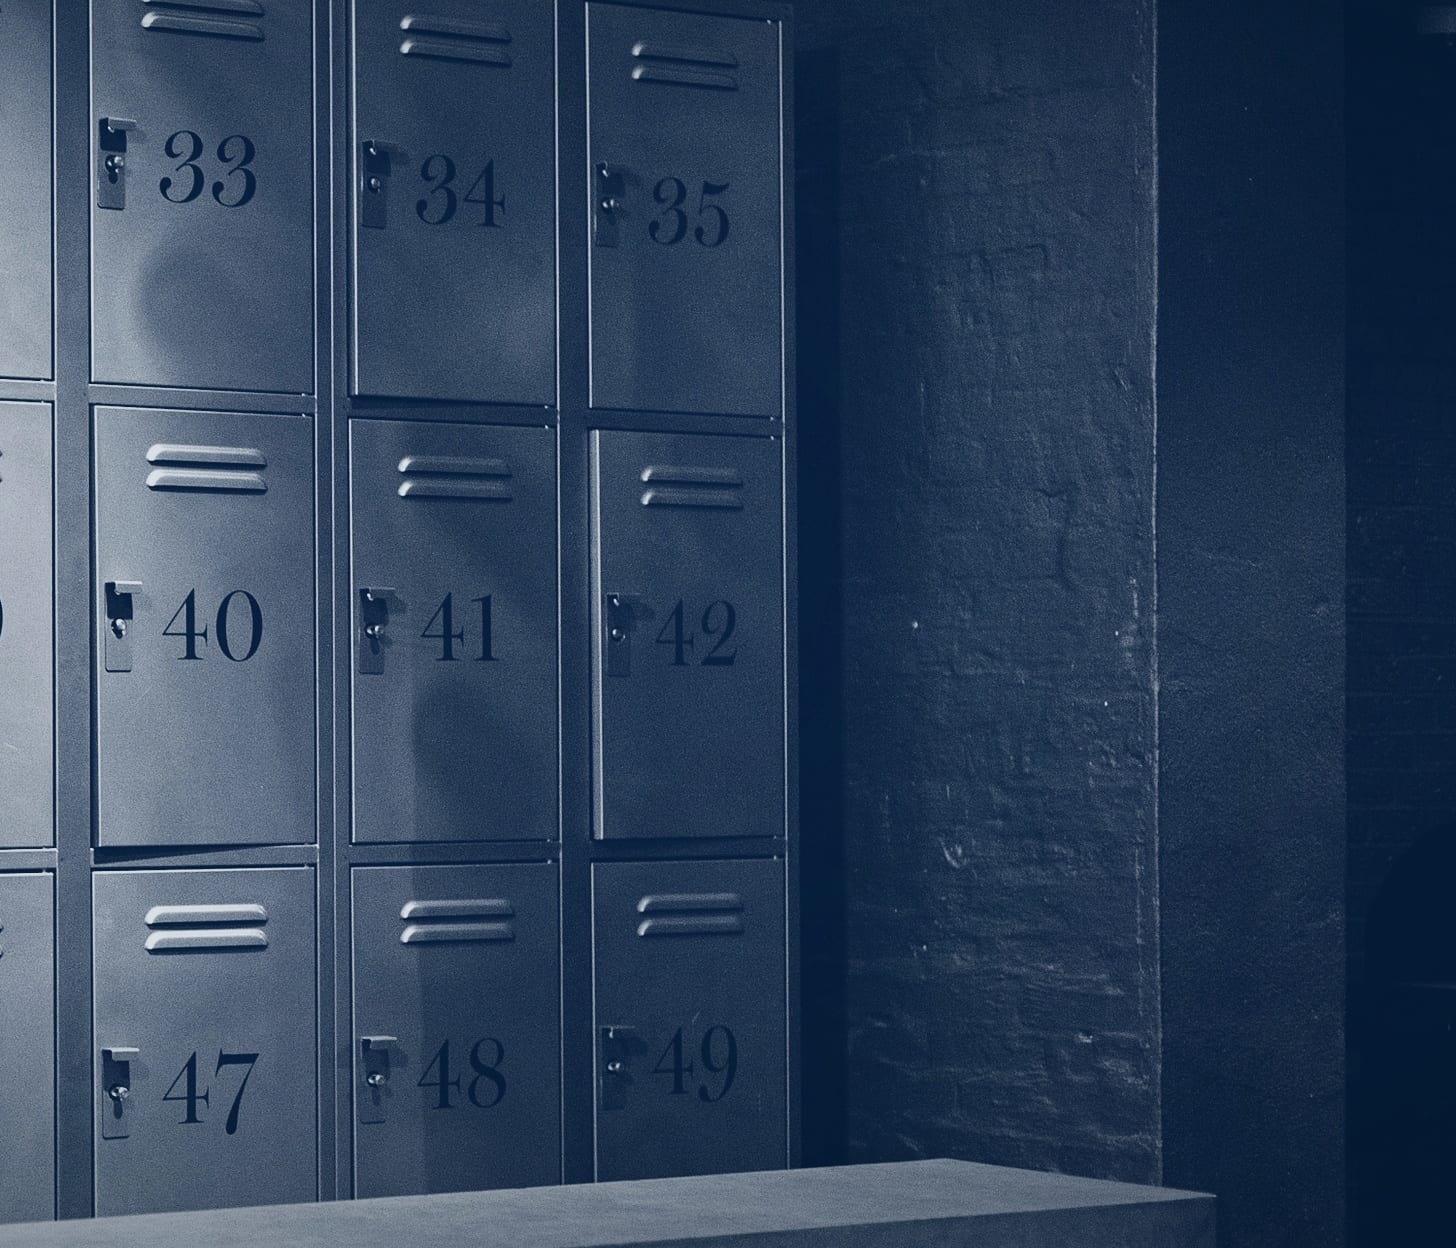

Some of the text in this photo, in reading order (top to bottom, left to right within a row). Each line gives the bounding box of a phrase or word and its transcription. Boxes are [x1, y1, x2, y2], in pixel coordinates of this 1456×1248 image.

[159, 130, 257, 208] 33
[416, 155, 505, 227] 34
[648, 176, 730, 248] 35
[163, 590, 263, 662] 40
[422, 593, 499, 662] 41
[656, 600, 737, 666] 42
[163, 1051, 259, 1135] 47
[418, 1037, 507, 1109] 48
[652, 1026, 737, 1103] 49
